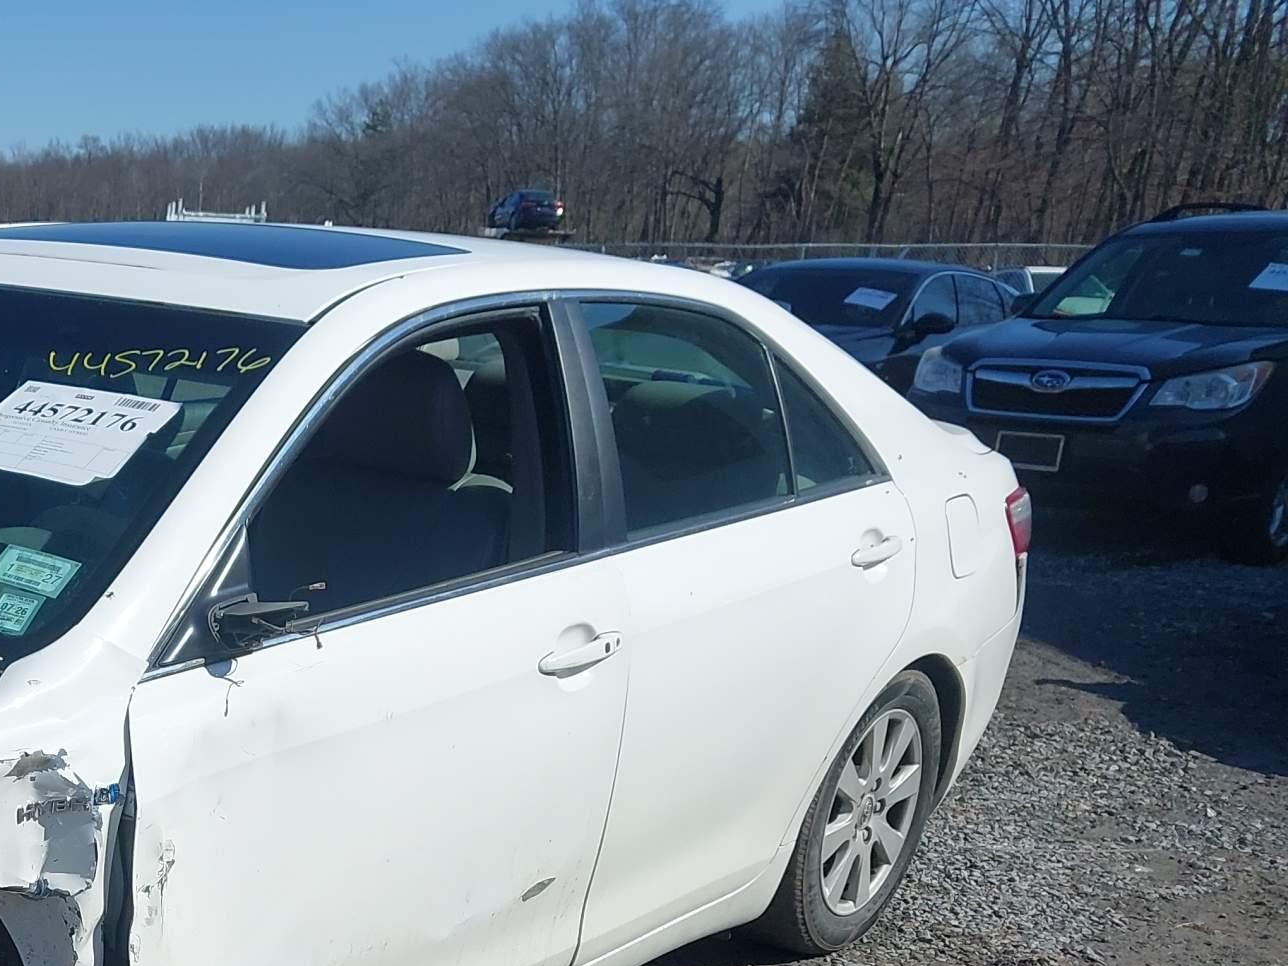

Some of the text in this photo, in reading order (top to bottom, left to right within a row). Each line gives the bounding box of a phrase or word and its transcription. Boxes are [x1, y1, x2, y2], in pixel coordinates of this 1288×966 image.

[49, 347, 272, 379] 44572176
[13, 399, 145, 432] 44572176
[41, 573, 63, 585] 27
[0, 602, 29, 616] 07-26
